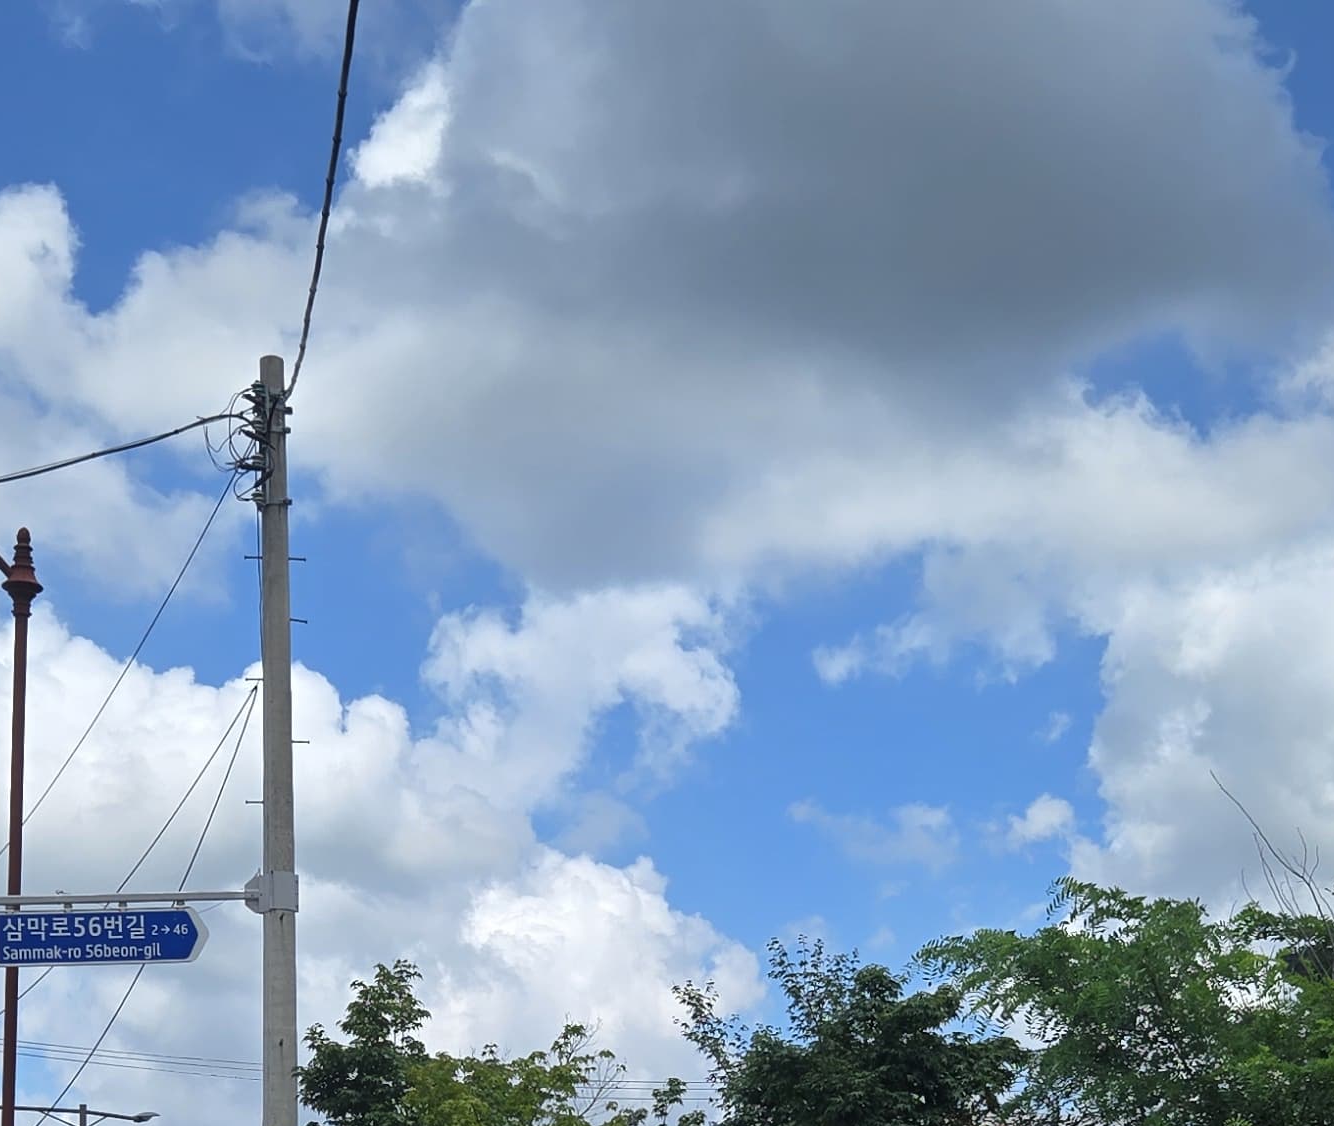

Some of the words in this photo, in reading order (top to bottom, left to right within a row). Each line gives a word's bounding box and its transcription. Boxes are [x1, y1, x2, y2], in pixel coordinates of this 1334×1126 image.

[2, 915, 146, 942] 삼막로56번길
[172, 923, 189, 936] 46
[2, 945, 81, 961] Sammak-ro
[85, 943, 162, 960] 56beon-gil
